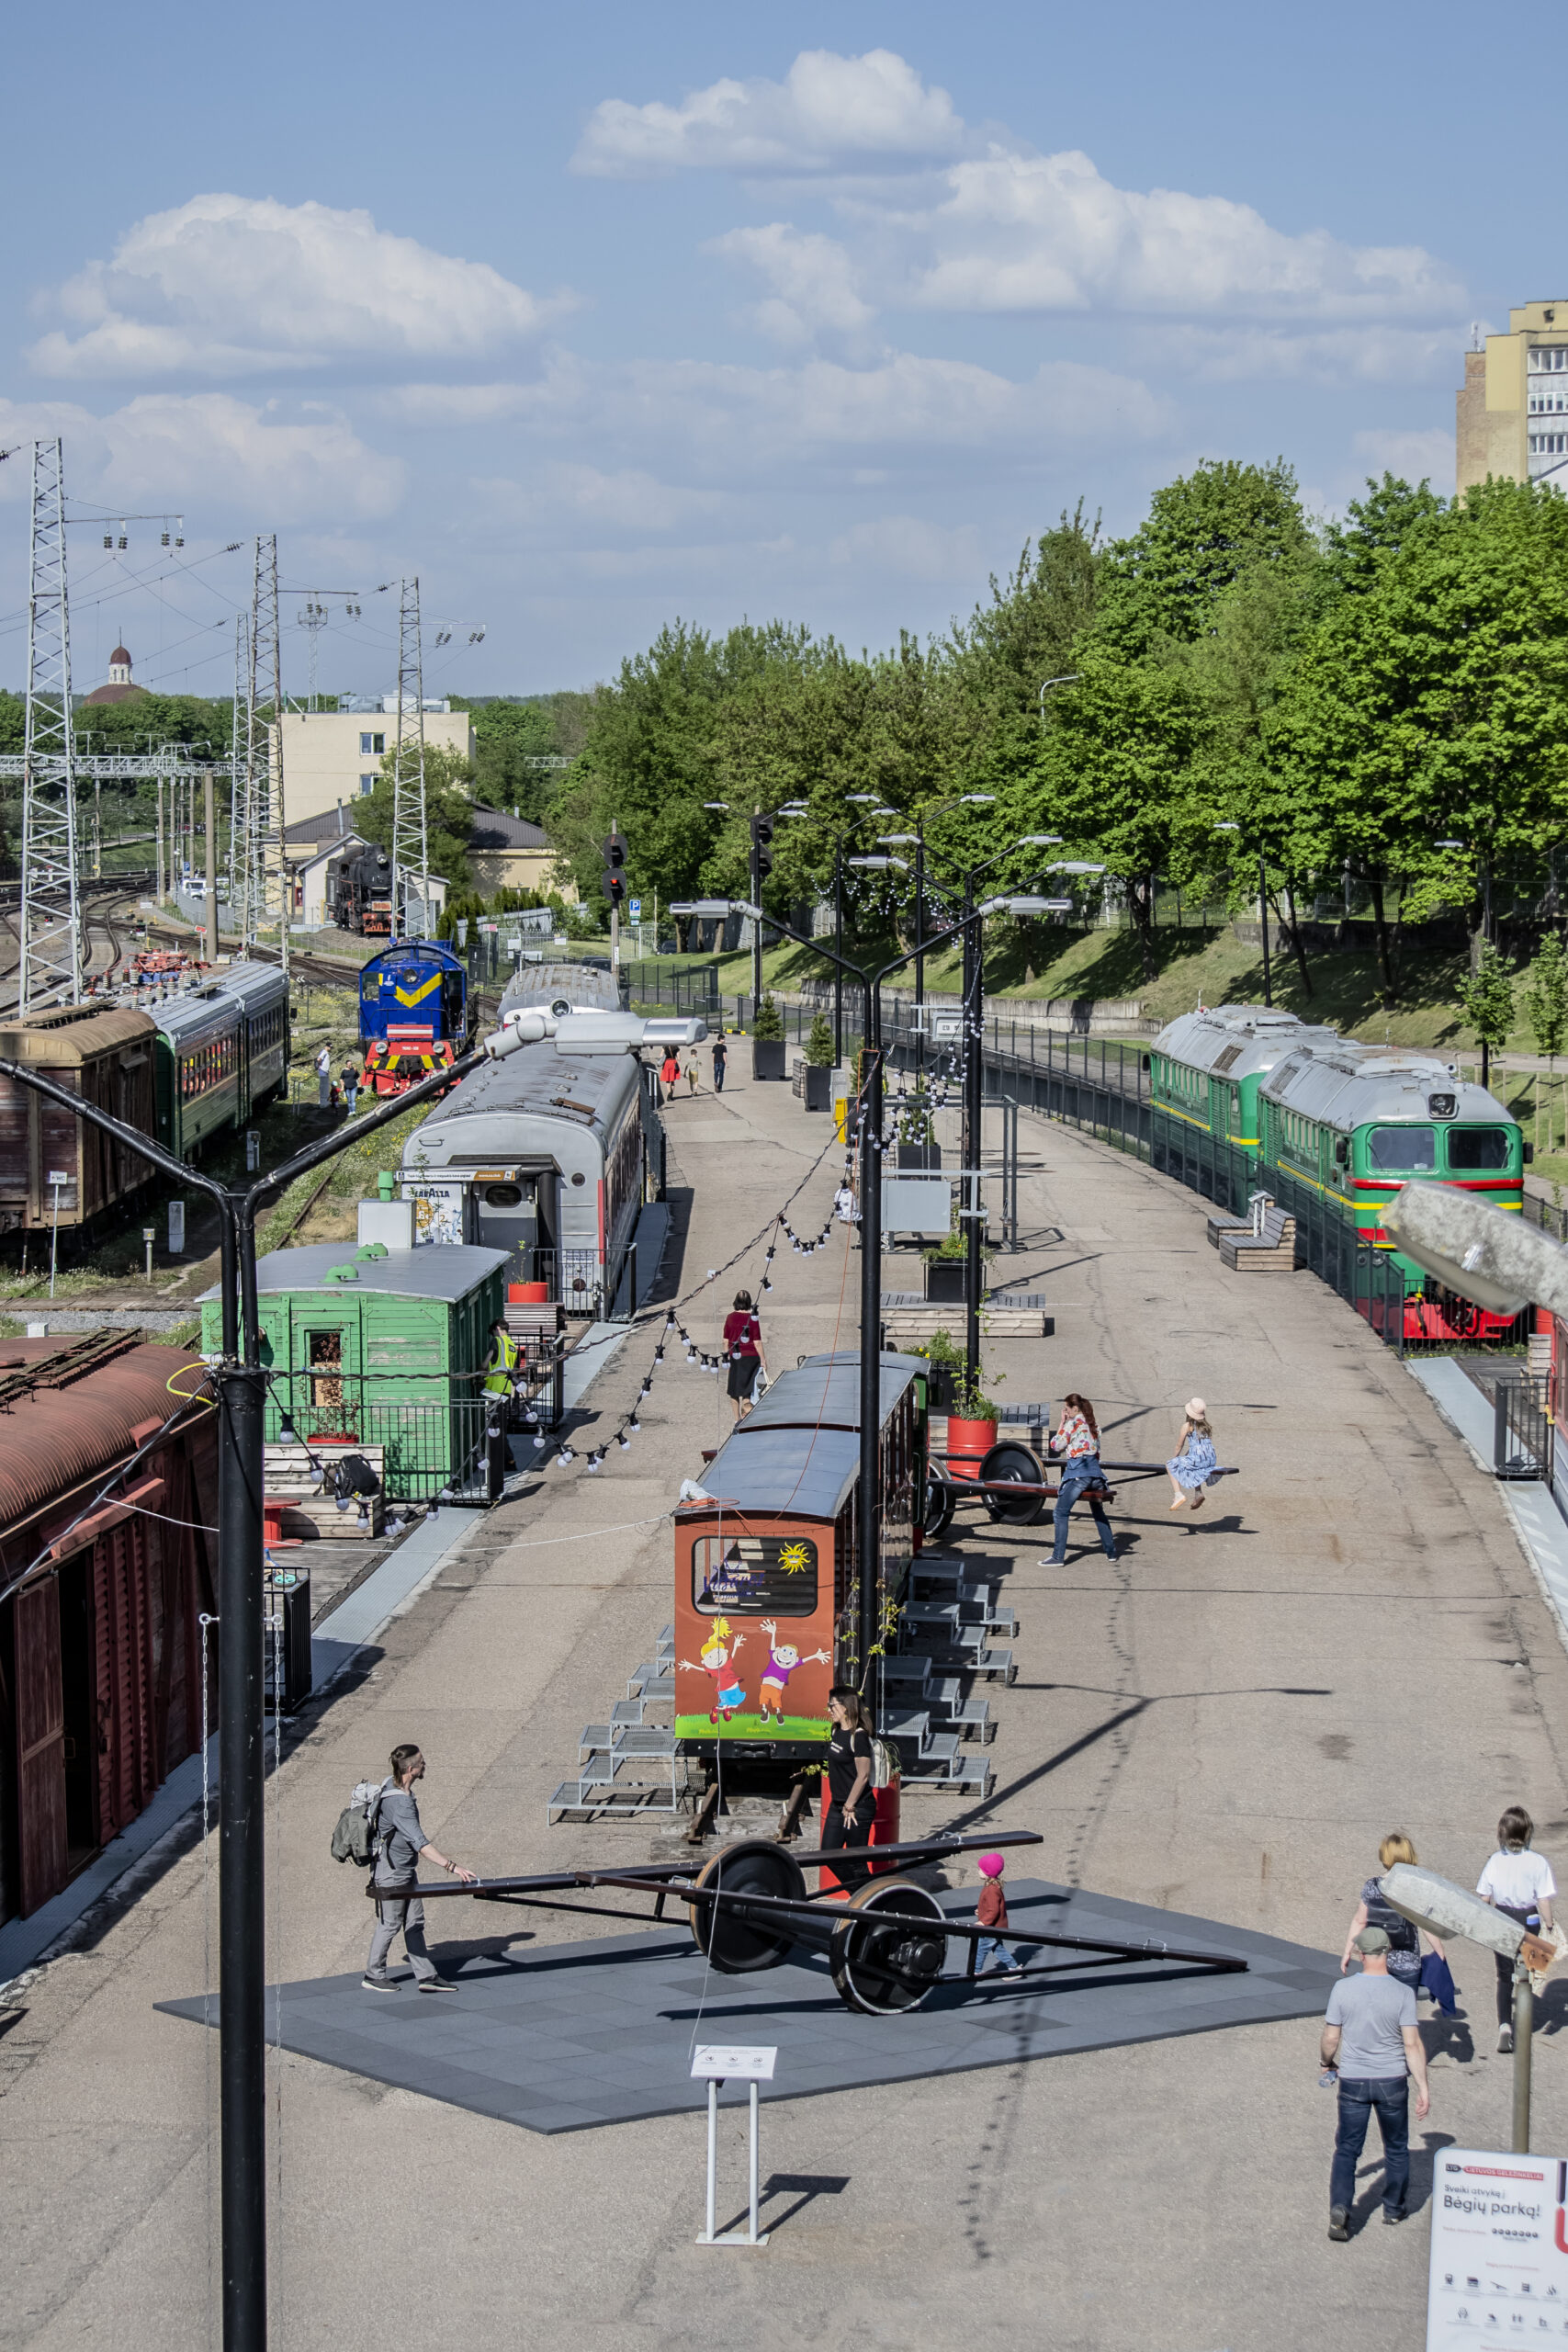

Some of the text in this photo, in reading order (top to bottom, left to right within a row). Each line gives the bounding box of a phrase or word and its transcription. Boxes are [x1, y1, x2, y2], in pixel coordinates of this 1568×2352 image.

[632, 901, 639, 910] P
[1466, 2166, 1495, 2175] LIETUVOS
[1444, 2184, 1469, 2194] Sveiki
[1444, 2195, 1540, 2219] Bėgių parką!
